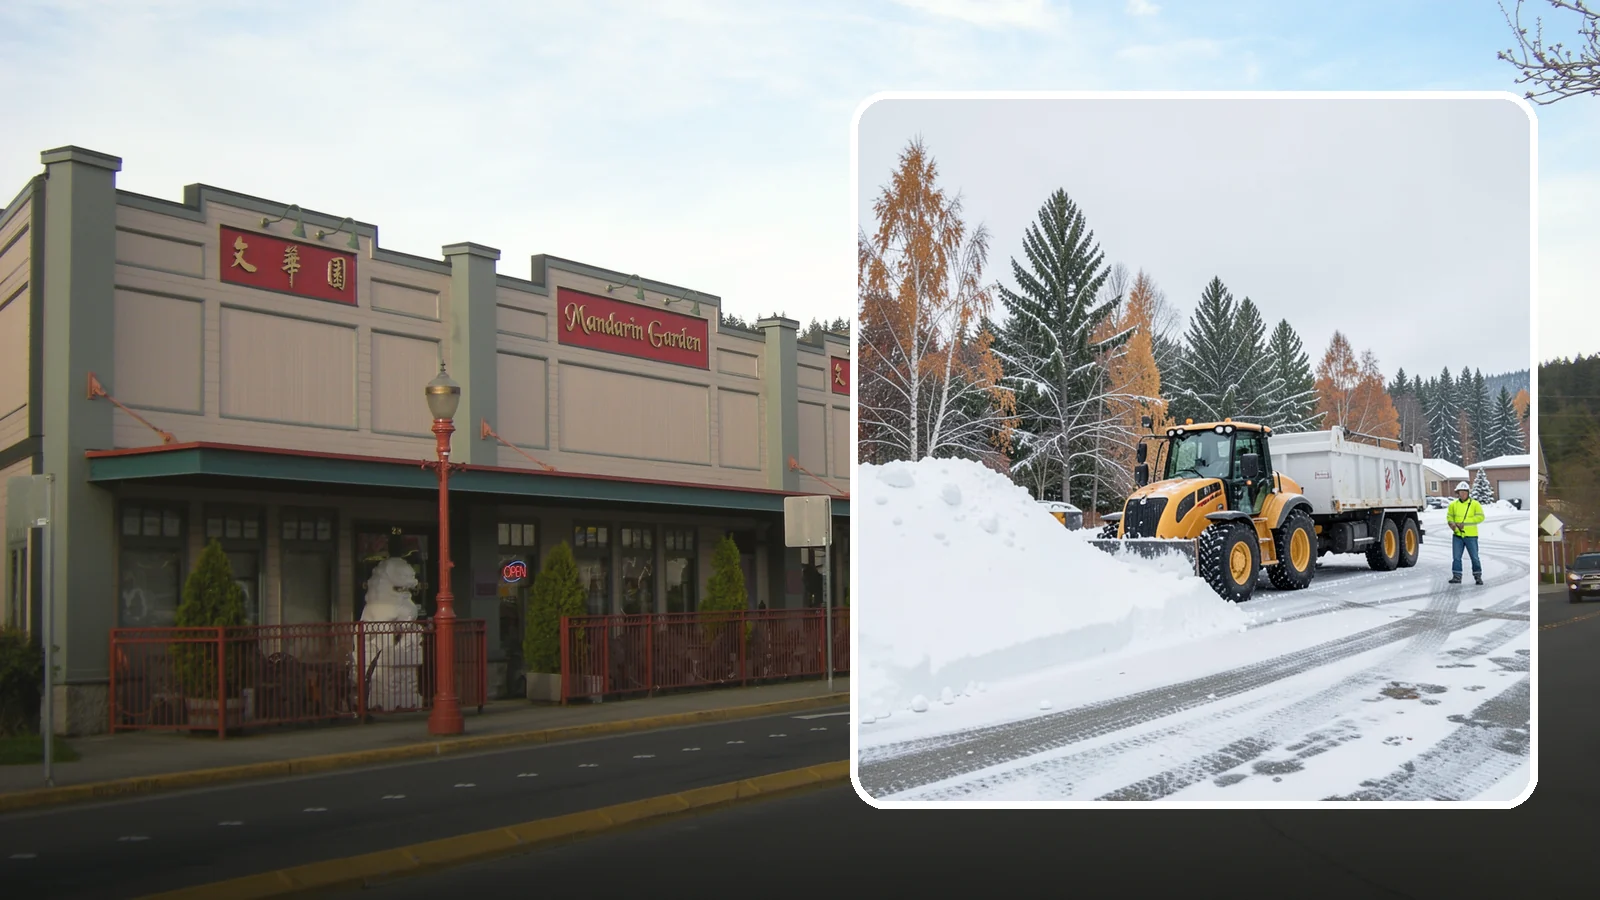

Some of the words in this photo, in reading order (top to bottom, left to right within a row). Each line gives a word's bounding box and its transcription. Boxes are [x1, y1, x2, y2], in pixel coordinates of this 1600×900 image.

[230, 235, 347, 291] 文華園
[564, 302, 644, 341] Mandarin
[647, 320, 701, 352] Garden
[834, 363, 847, 386] 文
[503, 565, 527, 578] OPEN
